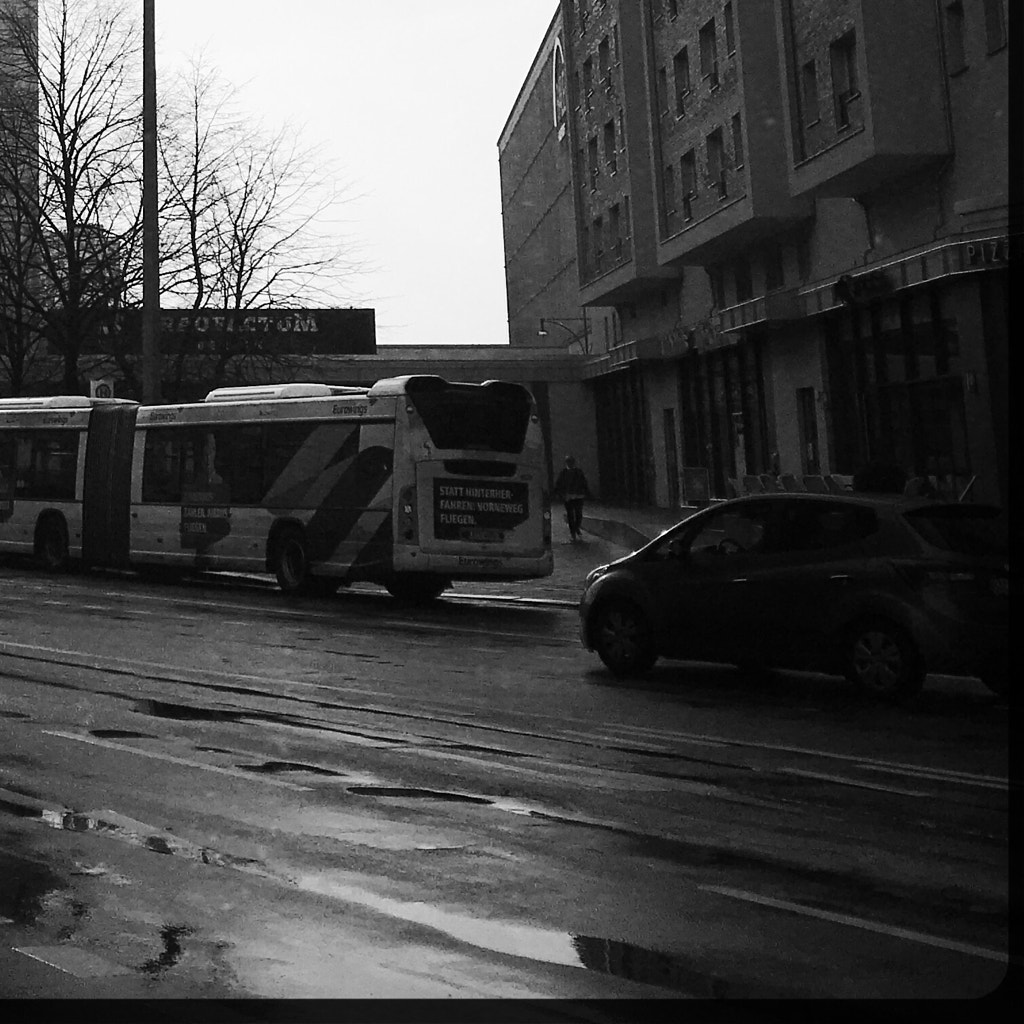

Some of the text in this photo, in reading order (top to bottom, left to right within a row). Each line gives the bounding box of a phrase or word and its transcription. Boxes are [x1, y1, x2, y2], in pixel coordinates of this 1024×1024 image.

[439, 486, 514, 500] STATT HINTERHER-
[477, 502, 524, 514] VORNEWEG
